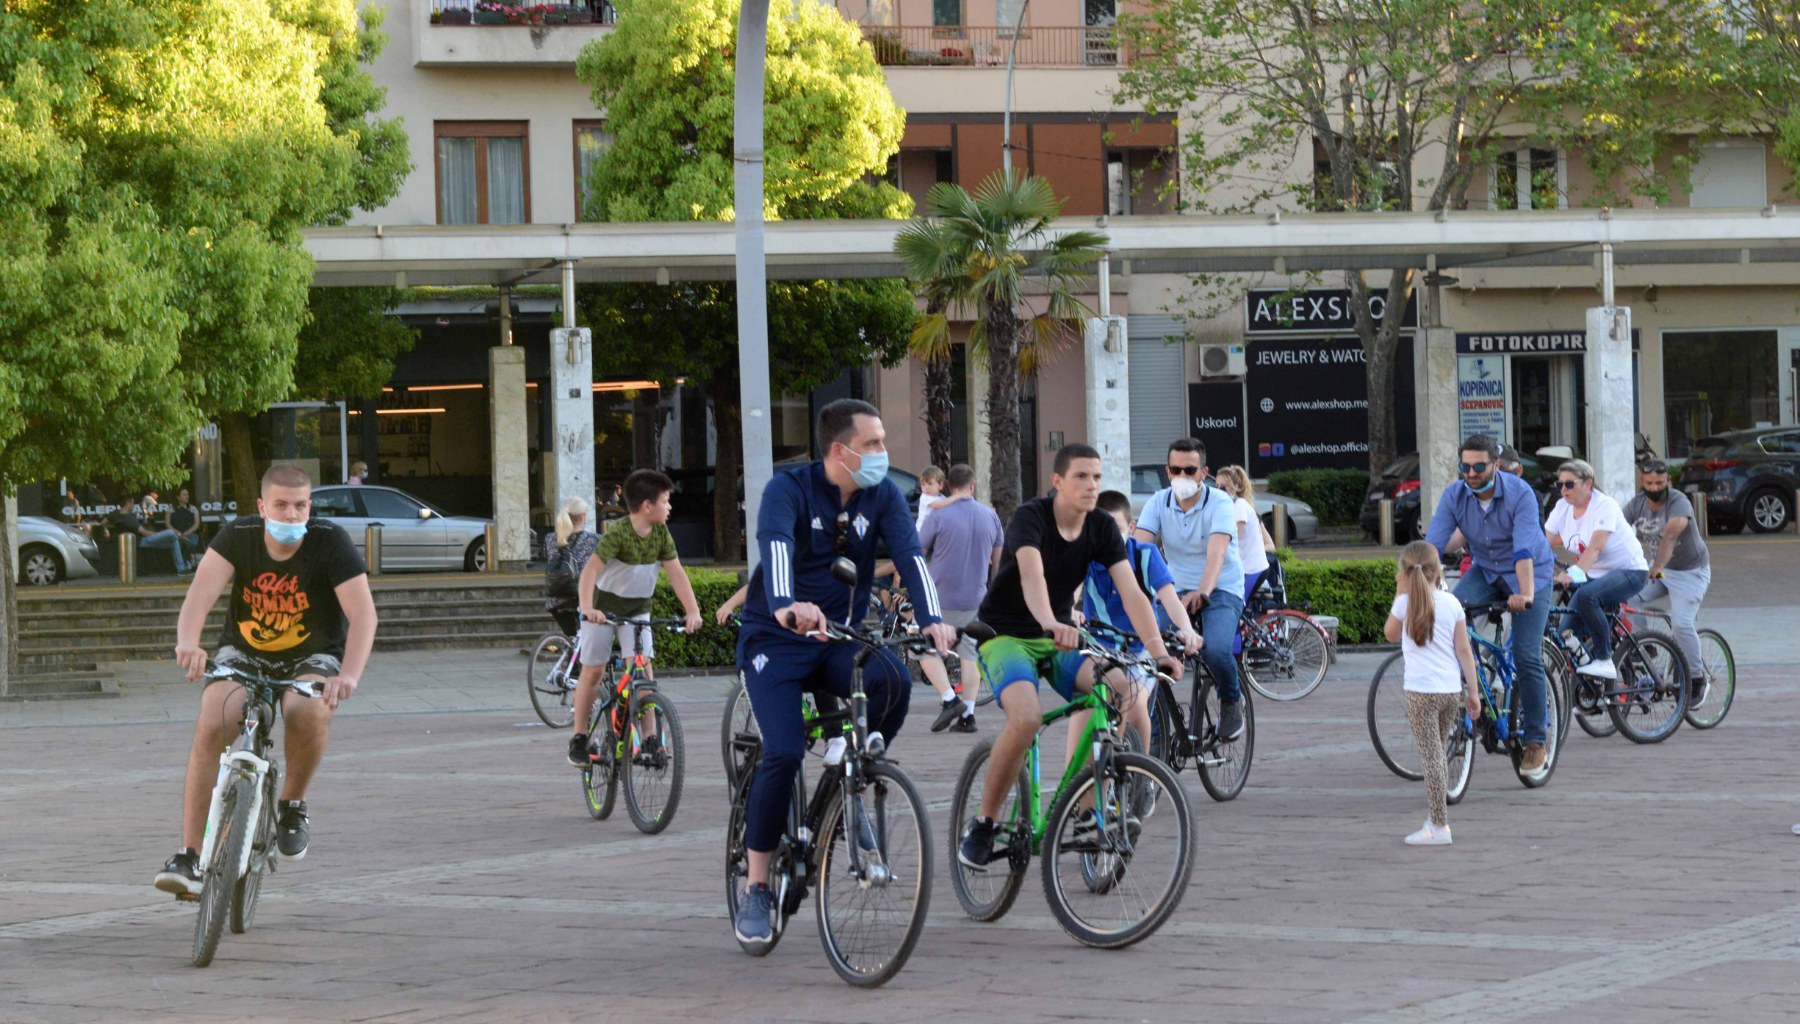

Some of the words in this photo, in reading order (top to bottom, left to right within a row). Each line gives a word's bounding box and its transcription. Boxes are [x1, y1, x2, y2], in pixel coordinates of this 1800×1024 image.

[1254, 296, 1386, 322] ALEXSO
[1469, 334, 1586, 351] FOTOKOPIR
[1256, 349, 1316, 365] JEWELRY
[1319, 349, 1329, 364] &
[1331, 348, 1367, 363] WATC
[1460, 380, 1503, 397] KOPIRNICA
[1285, 398, 1369, 411] www.alexshop.me
[1195, 416, 1237, 429] Uskoro!
[1290, 441, 1370, 456] @alexshop.officia
[252, 572, 299, 594] Hot
